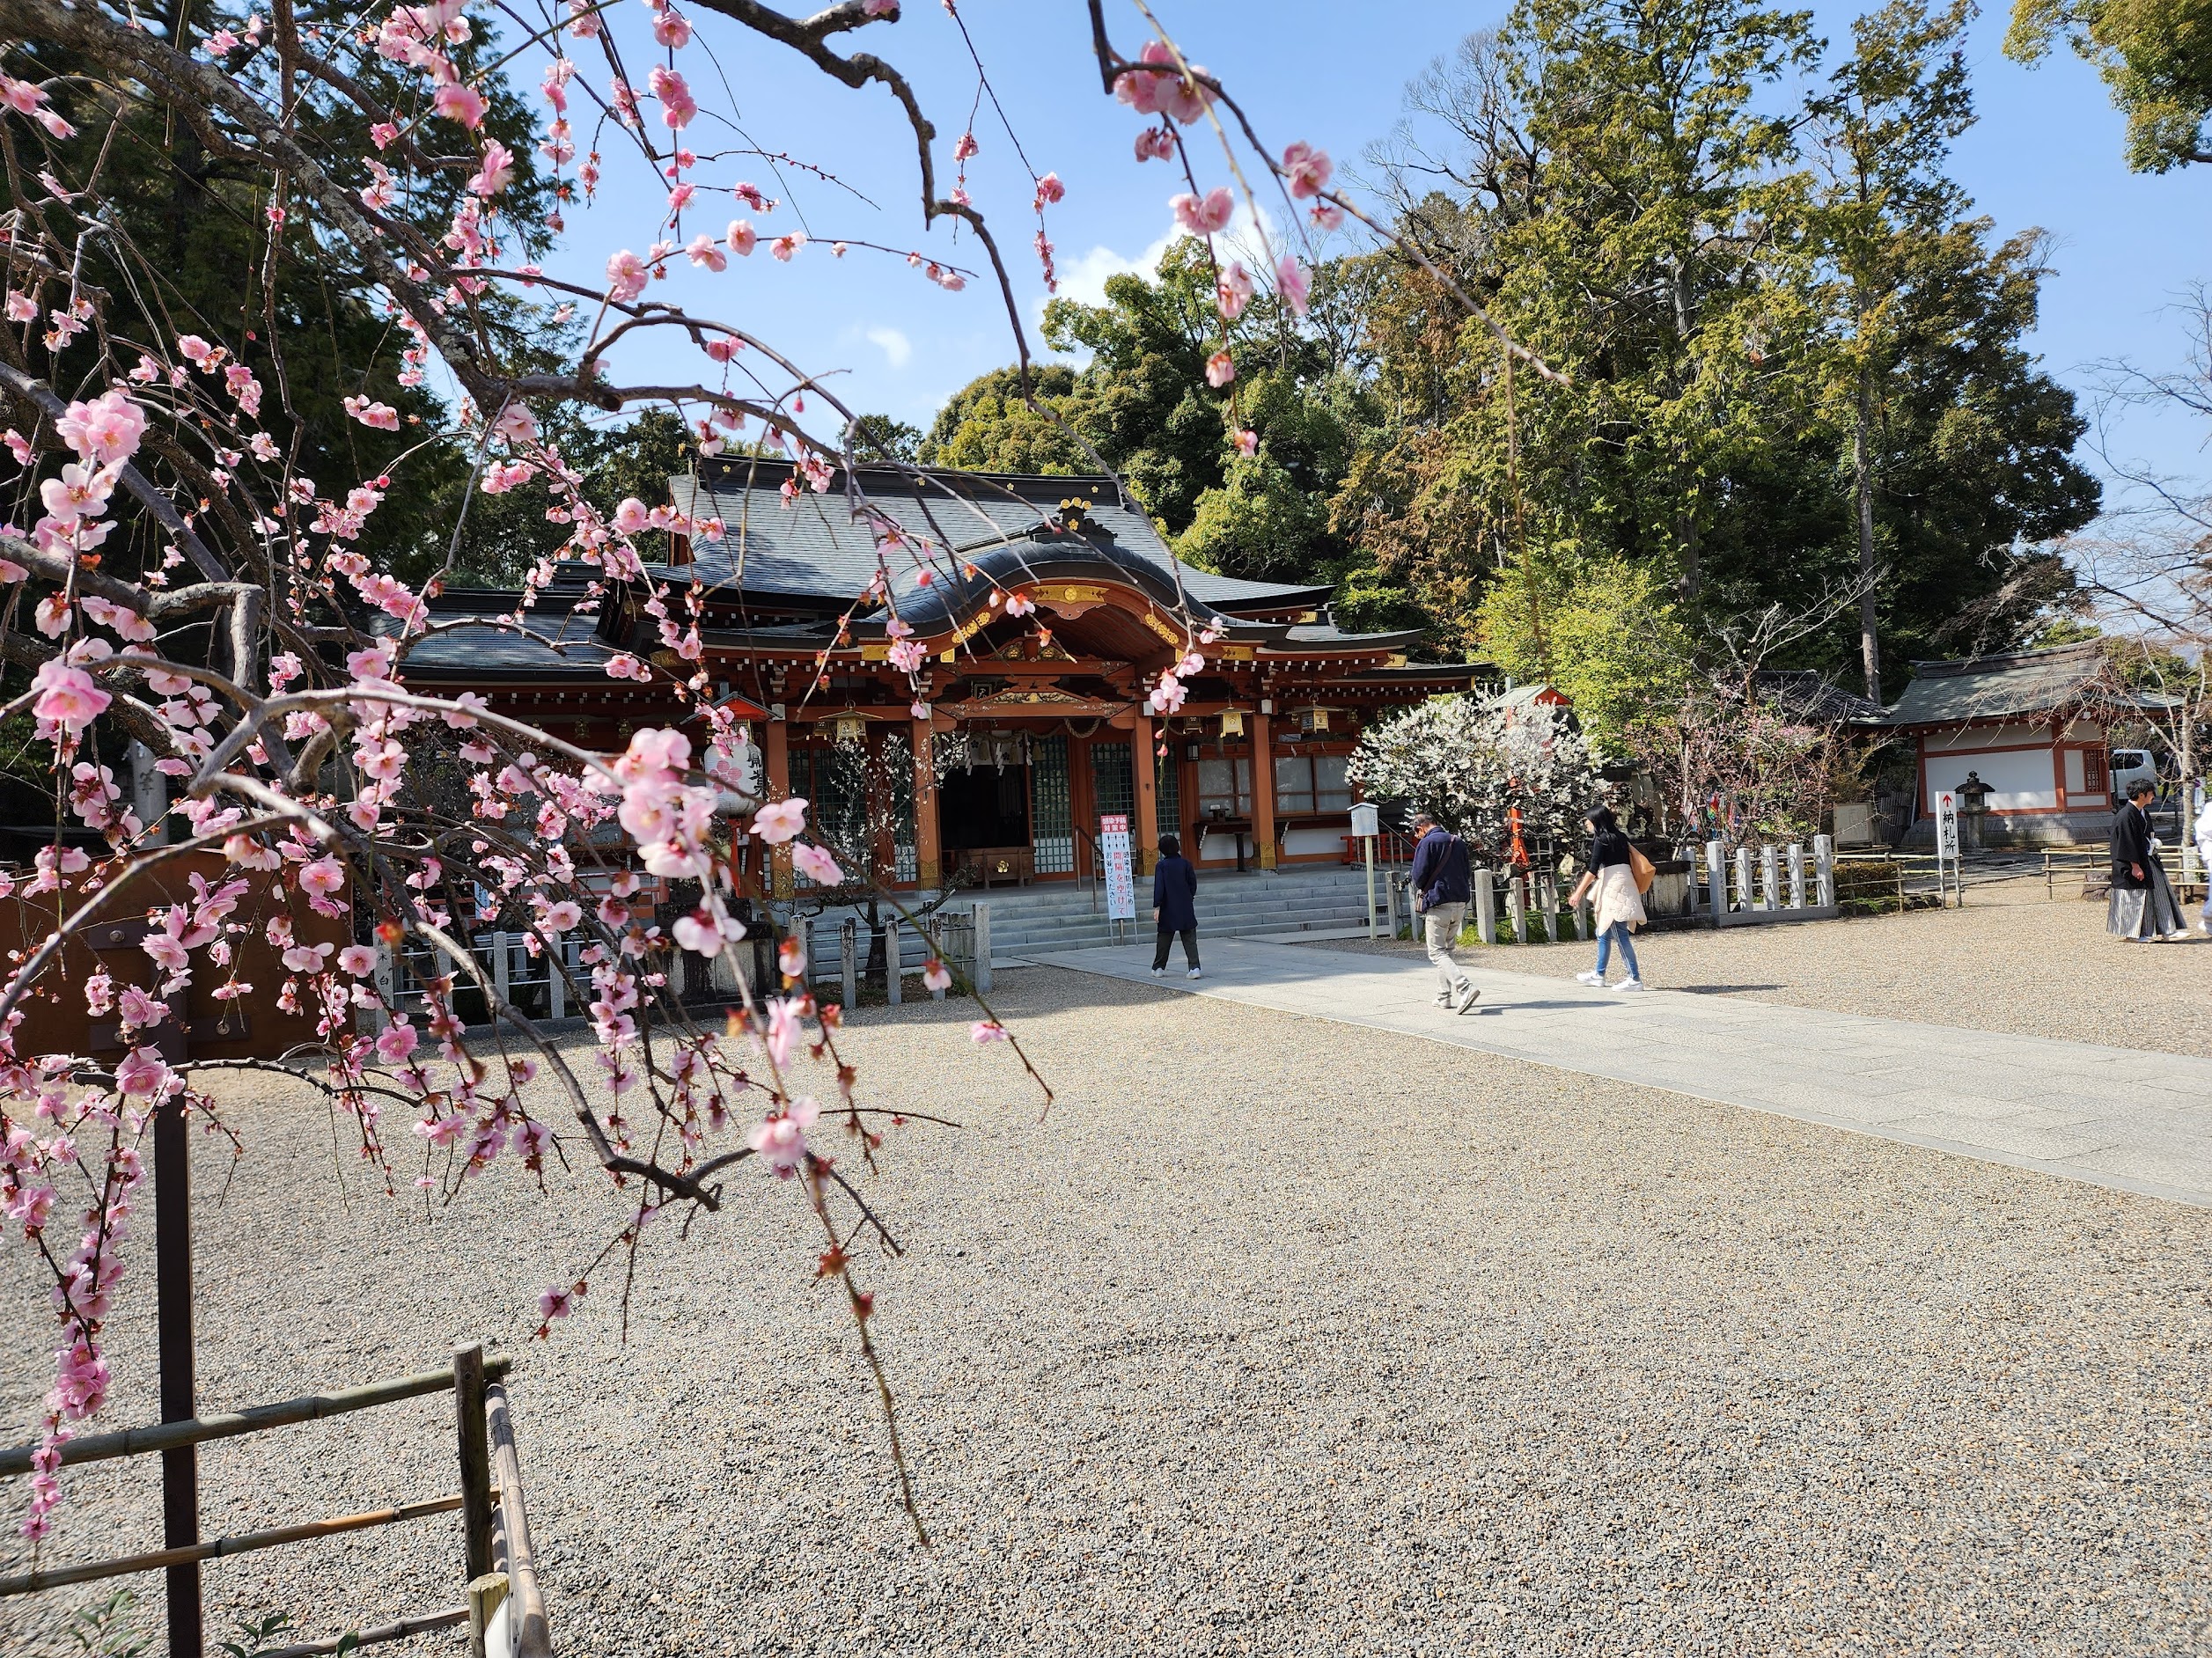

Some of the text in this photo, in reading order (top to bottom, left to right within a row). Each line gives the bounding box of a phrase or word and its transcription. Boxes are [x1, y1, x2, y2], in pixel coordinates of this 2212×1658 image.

[1943, 811, 1956, 855] 納札所
[1106, 852, 1116, 906] お並びください
[1113, 851, 1126, 915] 間隔を空けて
[1122, 851, 1134, 906] 感染予防のため
